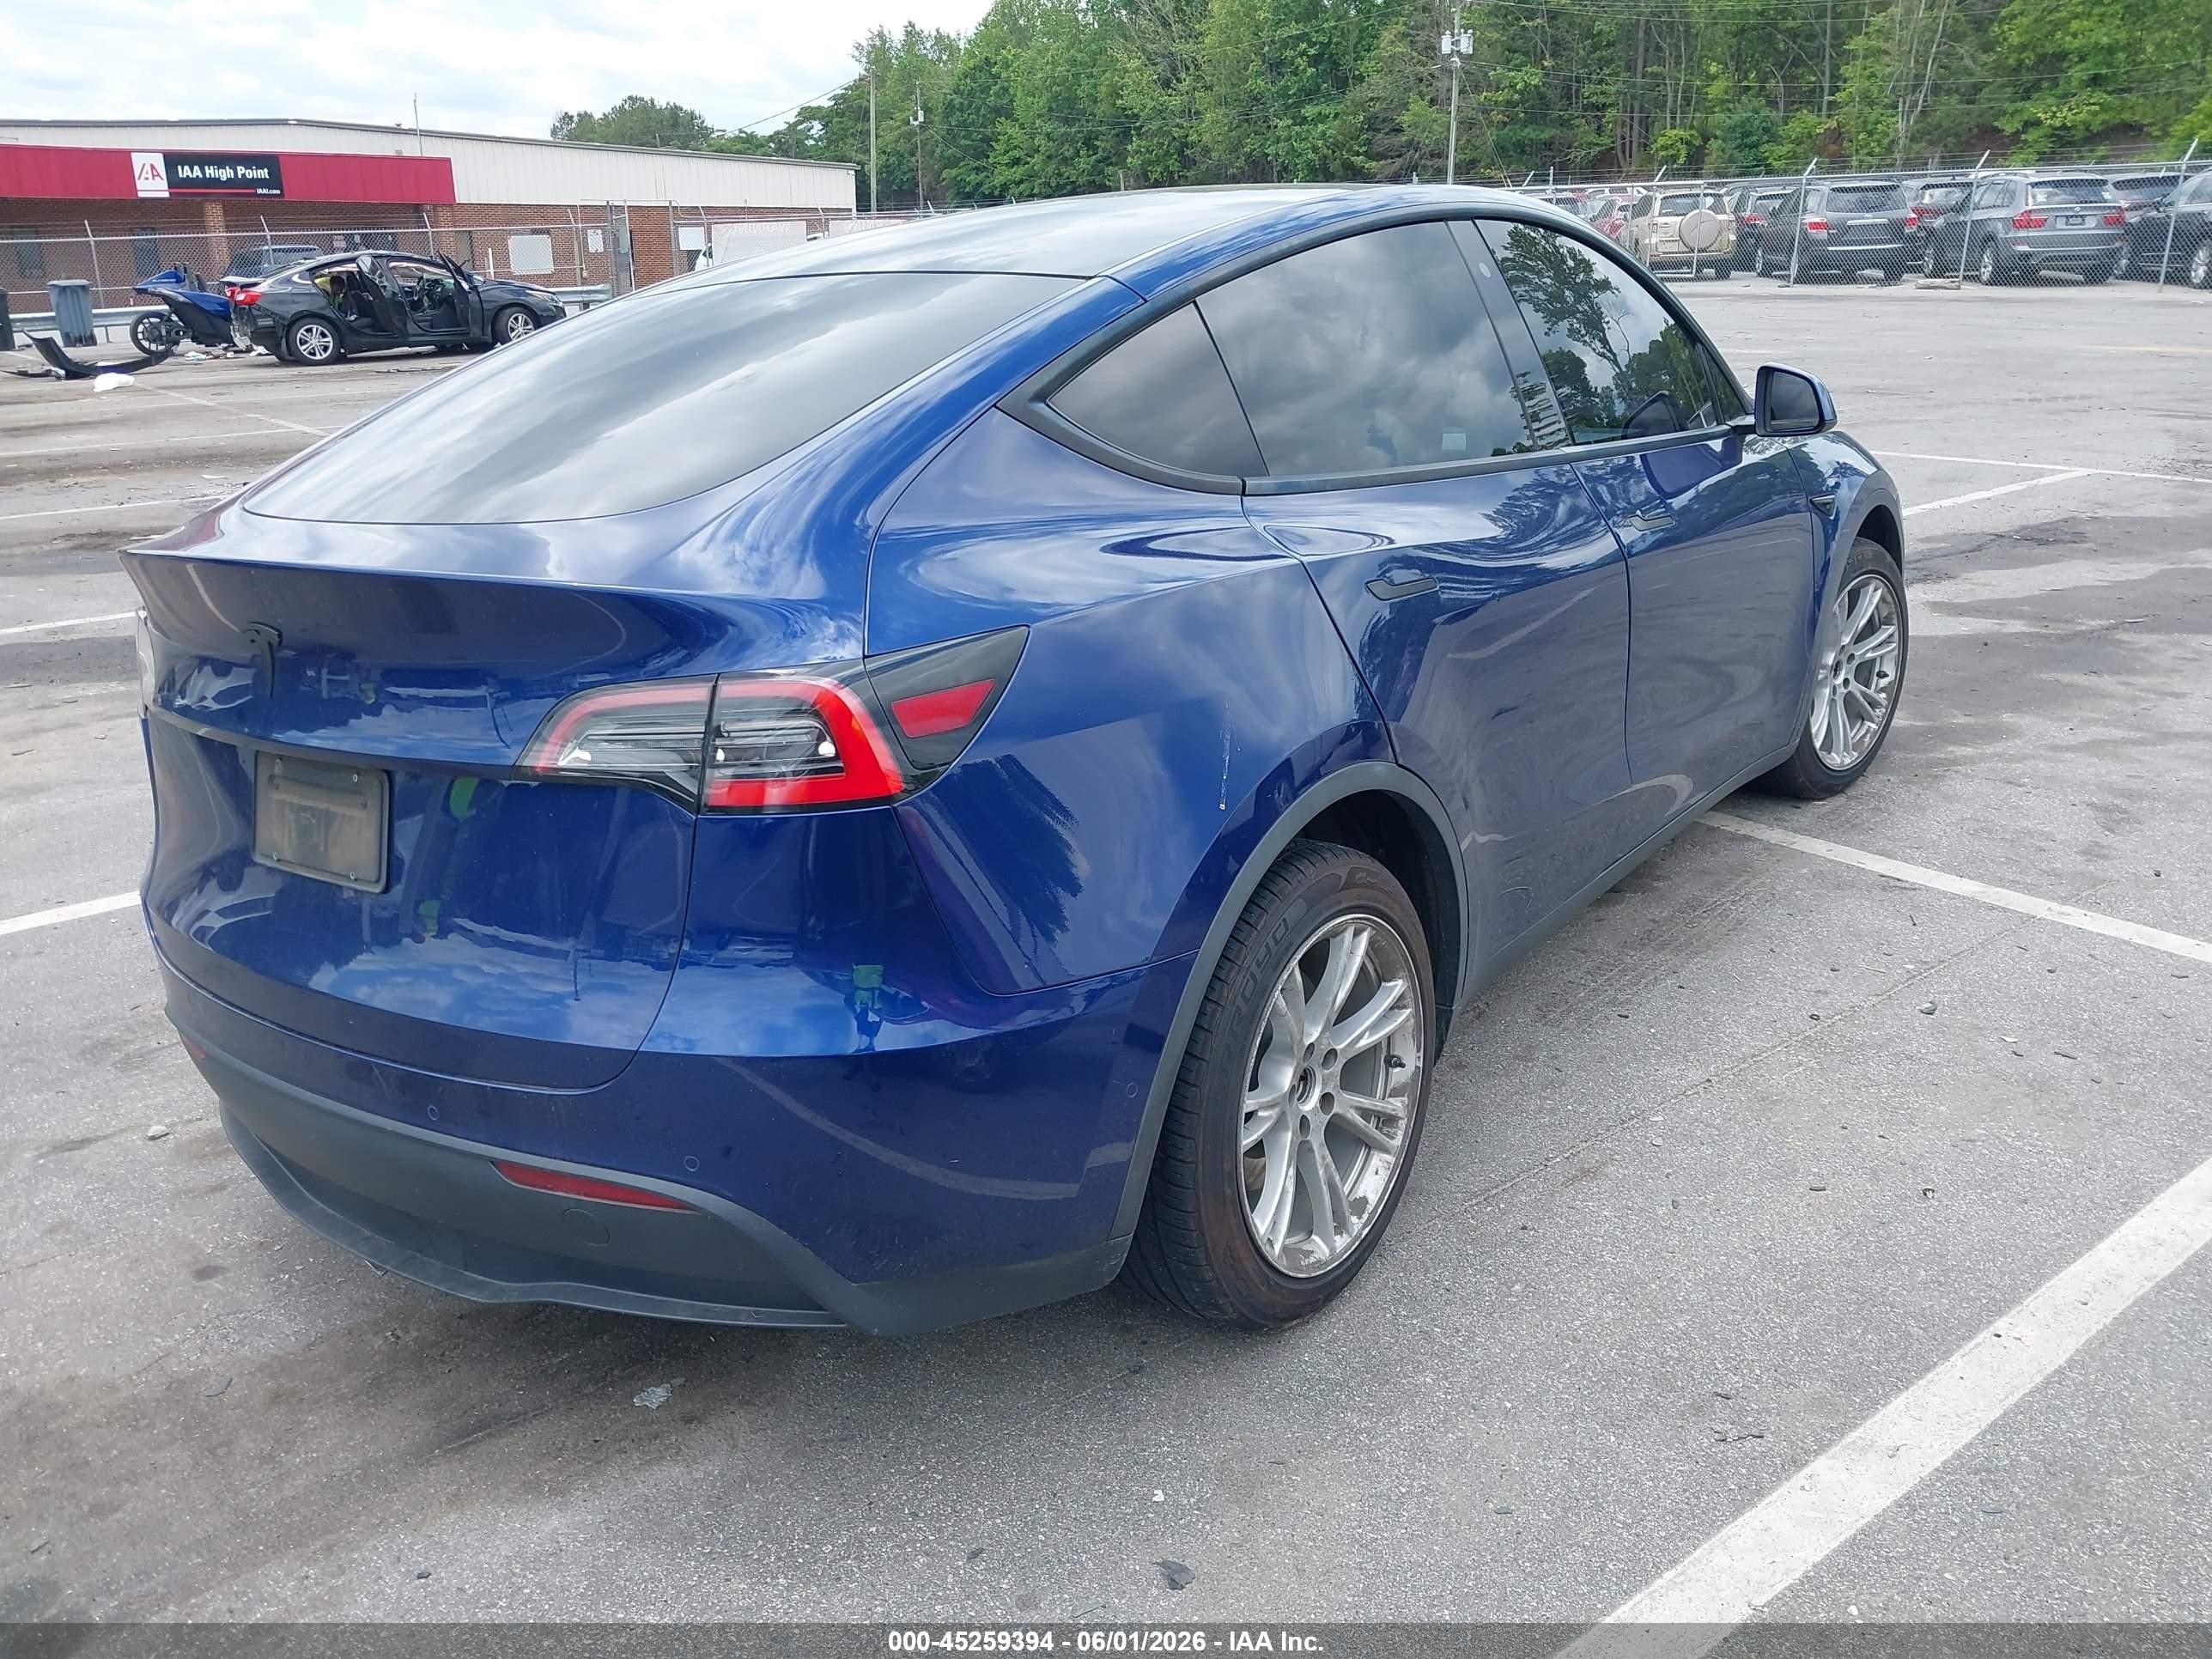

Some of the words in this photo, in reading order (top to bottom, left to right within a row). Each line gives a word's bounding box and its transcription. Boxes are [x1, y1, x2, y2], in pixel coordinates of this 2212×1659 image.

[177, 165, 204, 179] IAA
[204, 165, 234, 181] High
[236, 166, 270, 179] Point
